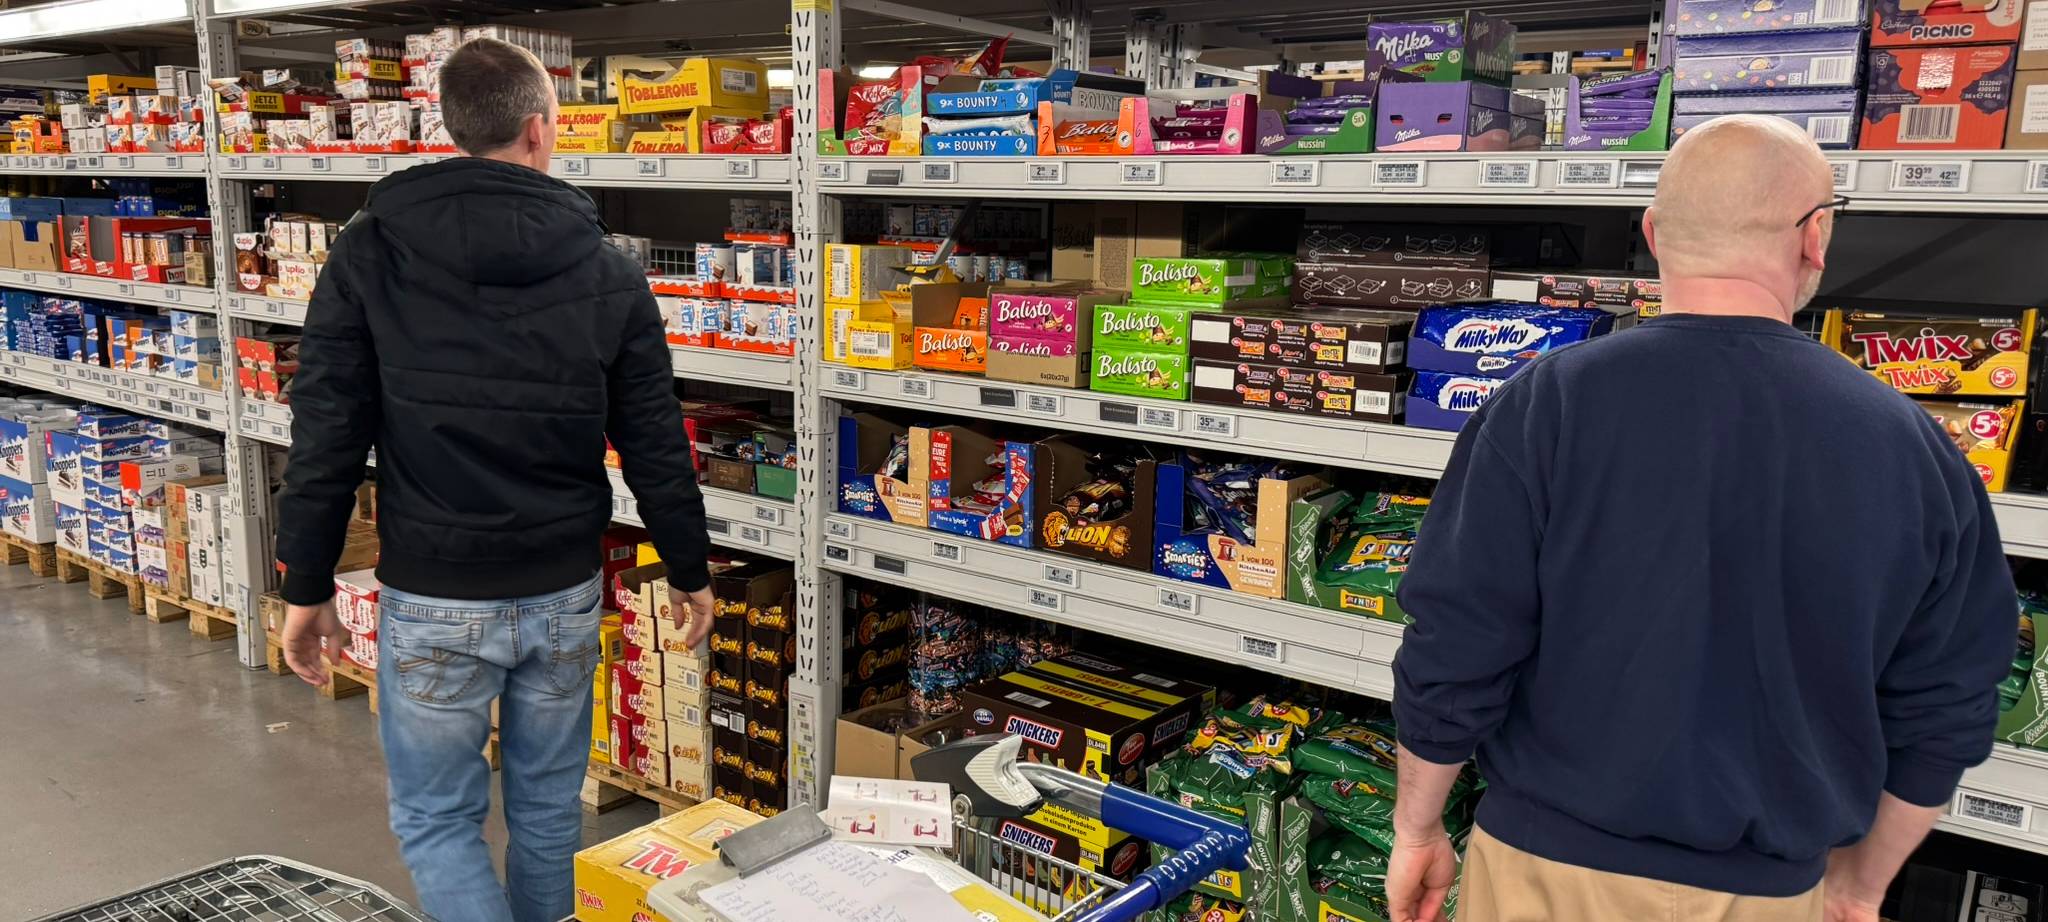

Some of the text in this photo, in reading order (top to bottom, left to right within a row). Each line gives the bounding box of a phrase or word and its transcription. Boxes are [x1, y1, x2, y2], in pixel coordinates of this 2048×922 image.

[1911, 24, 1974, 40] PICNIC
[1376, 31, 1434, 62] Milka
[1424, 52, 1444, 61] NUSS
[374, 63, 395, 71] JETZT
[626, 82, 698, 103] TOBLERONE
[253, 95, 277, 104] JETZT
[939, 96, 998, 108] 9x BOUNTY
[1078, 90, 1121, 112] BOUNT
[556, 113, 606, 125] OBLERONE
[1061, 116, 1117, 138] Balis
[1260, 133, 1285, 148] Milka
[1395, 128, 1420, 142] Milka
[1568, 134, 1592, 146] Milka
[1601, 137, 1629, 146] Nussini
[632, 140, 688, 153] TOBLERON
[869, 145, 884, 153] MIX
[937, 140, 997, 151] 9x BOUNTY
[1298, 140, 1325, 149] Nussini
[168, 268, 185, 281] han
[1139, 262, 1198, 287] Balisto
[997, 300, 1052, 322] Balisto
[1101, 311, 1160, 335] Balisto
[920, 333, 972, 354] Balisto
[1852, 328, 1973, 367] Twix
[1097, 355, 1157, 377] Balisto
[1884, 364, 1950, 388] Twix
[51, 457, 77, 474] Knoppers
[4, 503, 29, 519] Knoppers
[57, 518, 81, 531] Knoppers
[1066, 525, 1112, 546] LION
[1260, 558, 1274, 566] 100
[726, 602, 747, 614] LION
[760, 615, 782, 624] LION
[720, 640, 738, 651] LION
[757, 650, 775, 661] LION
[720, 679, 737, 689] LION
[755, 689, 773, 700] LION
[759, 729, 777, 740] LION
[1007, 718, 1061, 746] SNICKERS
[1155, 714, 1188, 742] SNICKERS
[723, 756, 740, 765] LION
[755, 770, 773, 781] LION
[1049, 817, 1067, 829] einem
[1067, 823, 1087, 836] Karton
[1002, 823, 1053, 854] SNICKERS
[1255, 842, 1273, 872] BOUNTY
[577, 888, 604, 911] Twix
